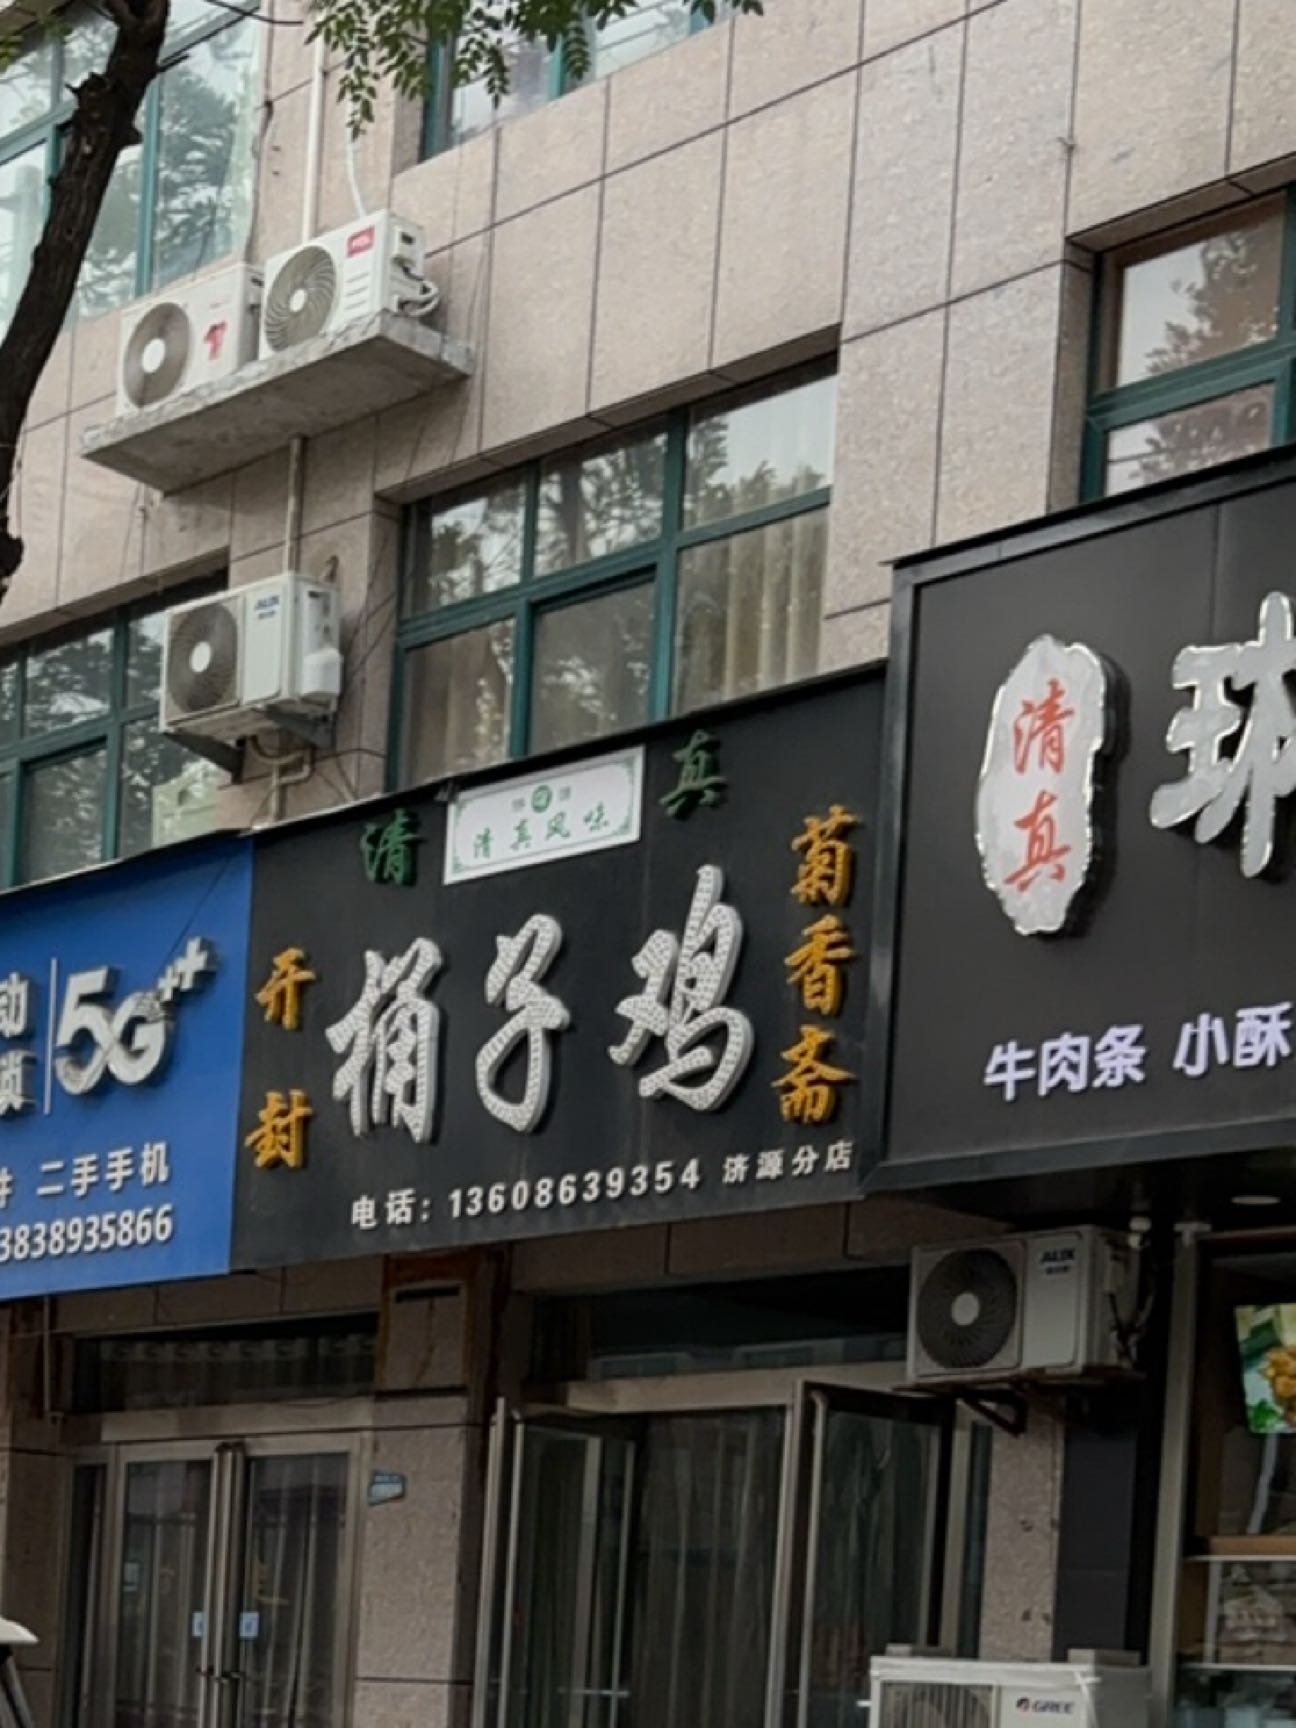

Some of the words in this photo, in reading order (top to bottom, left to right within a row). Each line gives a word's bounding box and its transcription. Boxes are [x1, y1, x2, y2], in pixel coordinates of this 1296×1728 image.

[361, 811, 425, 886] 清
[661, 729, 729, 816] 真
[1005, 679, 1074, 892] 清真
[245, 947, 316, 1169] 开封
[324, 864, 755, 1144] 桶子鸡
[983, 1022, 1147, 1102] 牛肉条
[1173, 1001, 1293, 1077] 小酥
[37, 1142, 171, 1199] 二手手机
[722, 1139, 854, 1185] 济源分店
